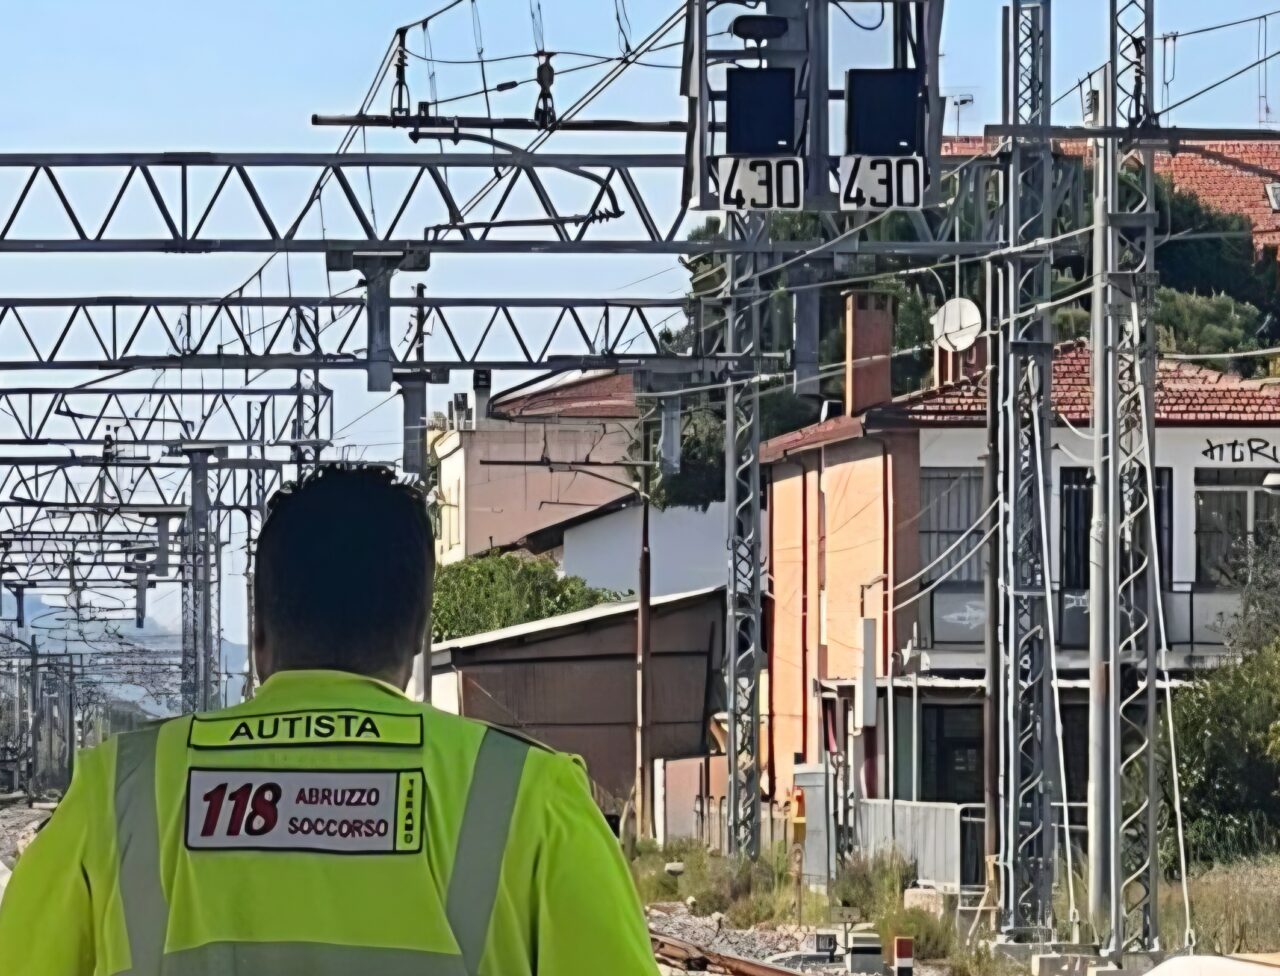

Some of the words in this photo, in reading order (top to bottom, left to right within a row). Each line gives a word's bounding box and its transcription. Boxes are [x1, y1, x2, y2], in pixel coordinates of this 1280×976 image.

[723, 158, 800, 209] 430
[843, 157, 920, 208] 430
[229, 715, 381, 742] AUTISTA
[200, 782, 283, 837] 118
[295, 786, 380, 807] ABRUZZO
[287, 816, 389, 838] SOCCORSO
